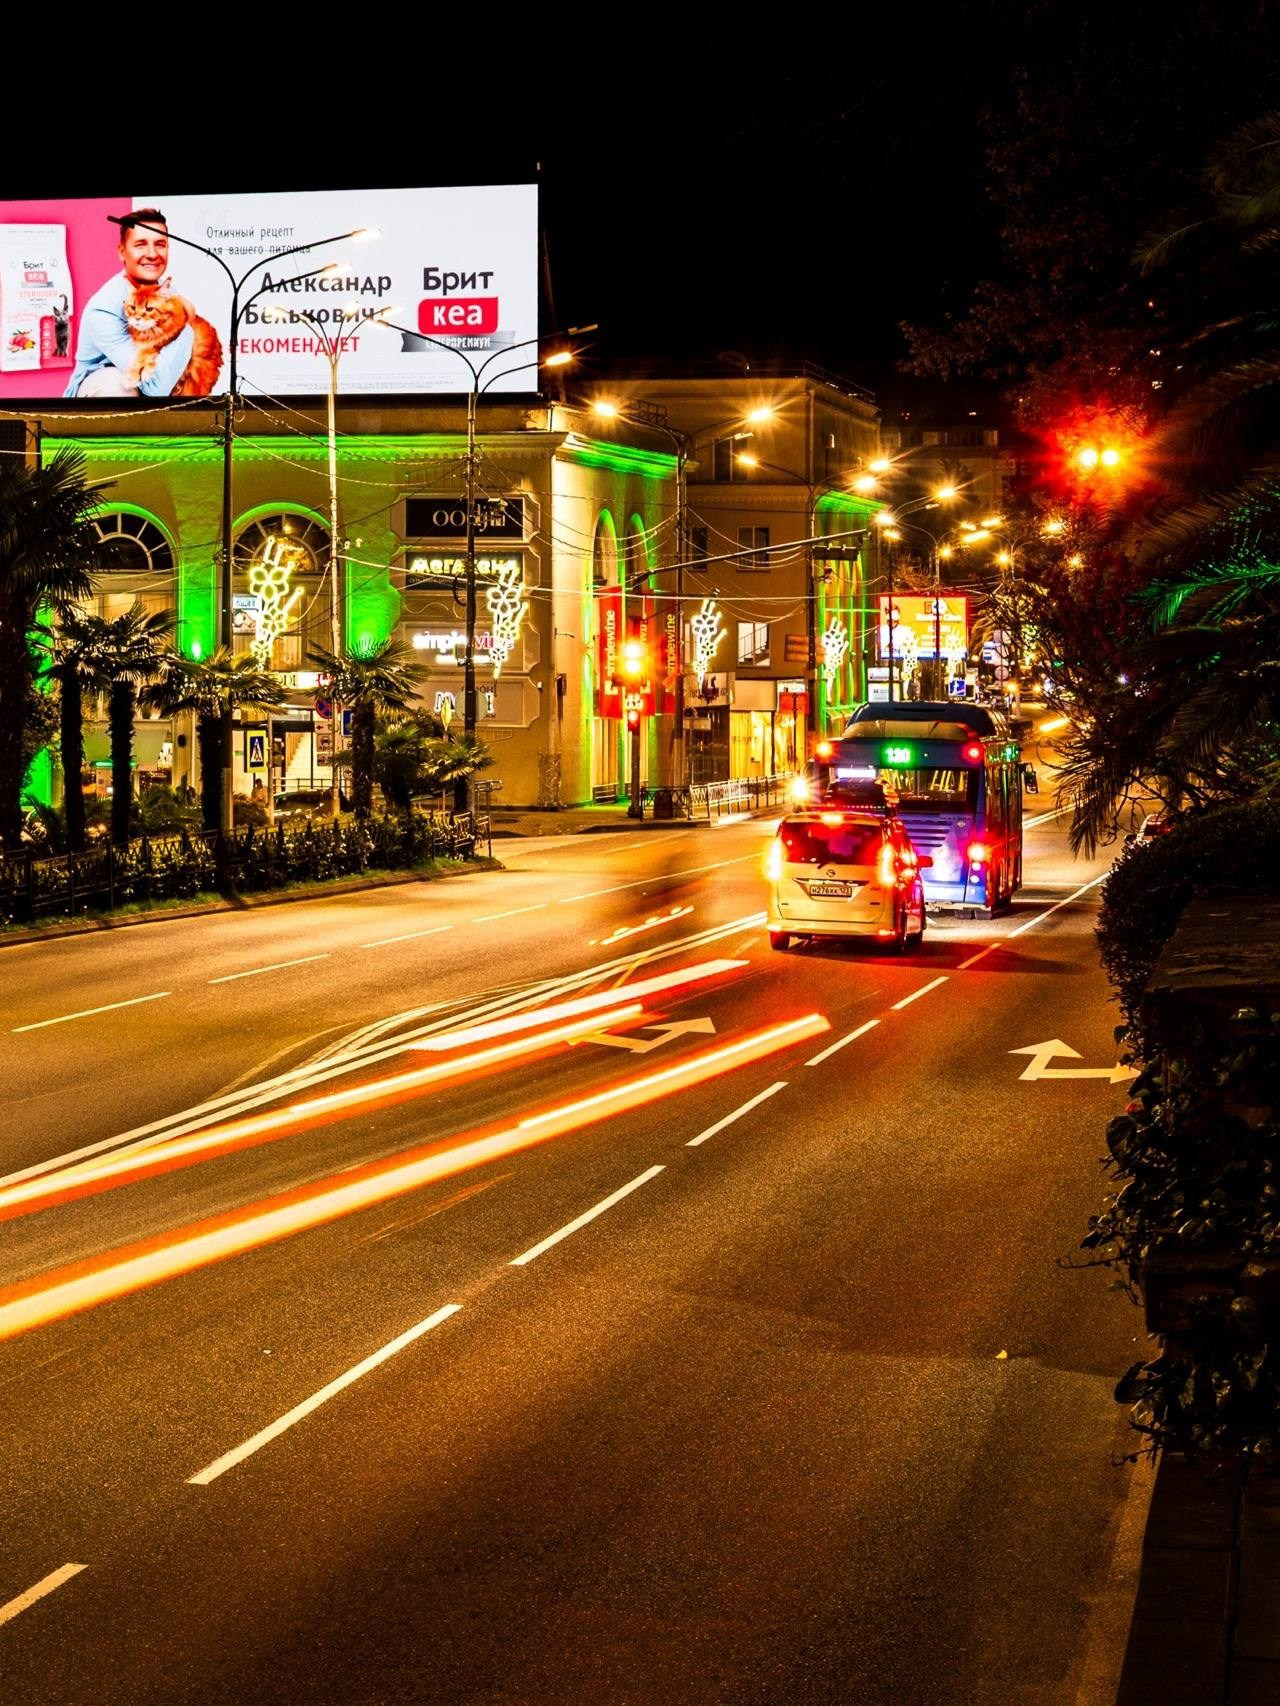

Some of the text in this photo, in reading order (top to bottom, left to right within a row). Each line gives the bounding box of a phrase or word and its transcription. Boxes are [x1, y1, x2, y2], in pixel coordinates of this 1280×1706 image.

[206, 226, 295, 241] Отличный рецепт
[228, 245, 264, 255] вашего
[261, 271, 392, 297] Александр
[423, 267, 494, 296] Брит
[433, 304, 483, 327] кеа
[233, 336, 360, 357] ЕКОМЕНДУЕТ
[425, 336, 491, 349] СУЕРПРЕМИУМ
